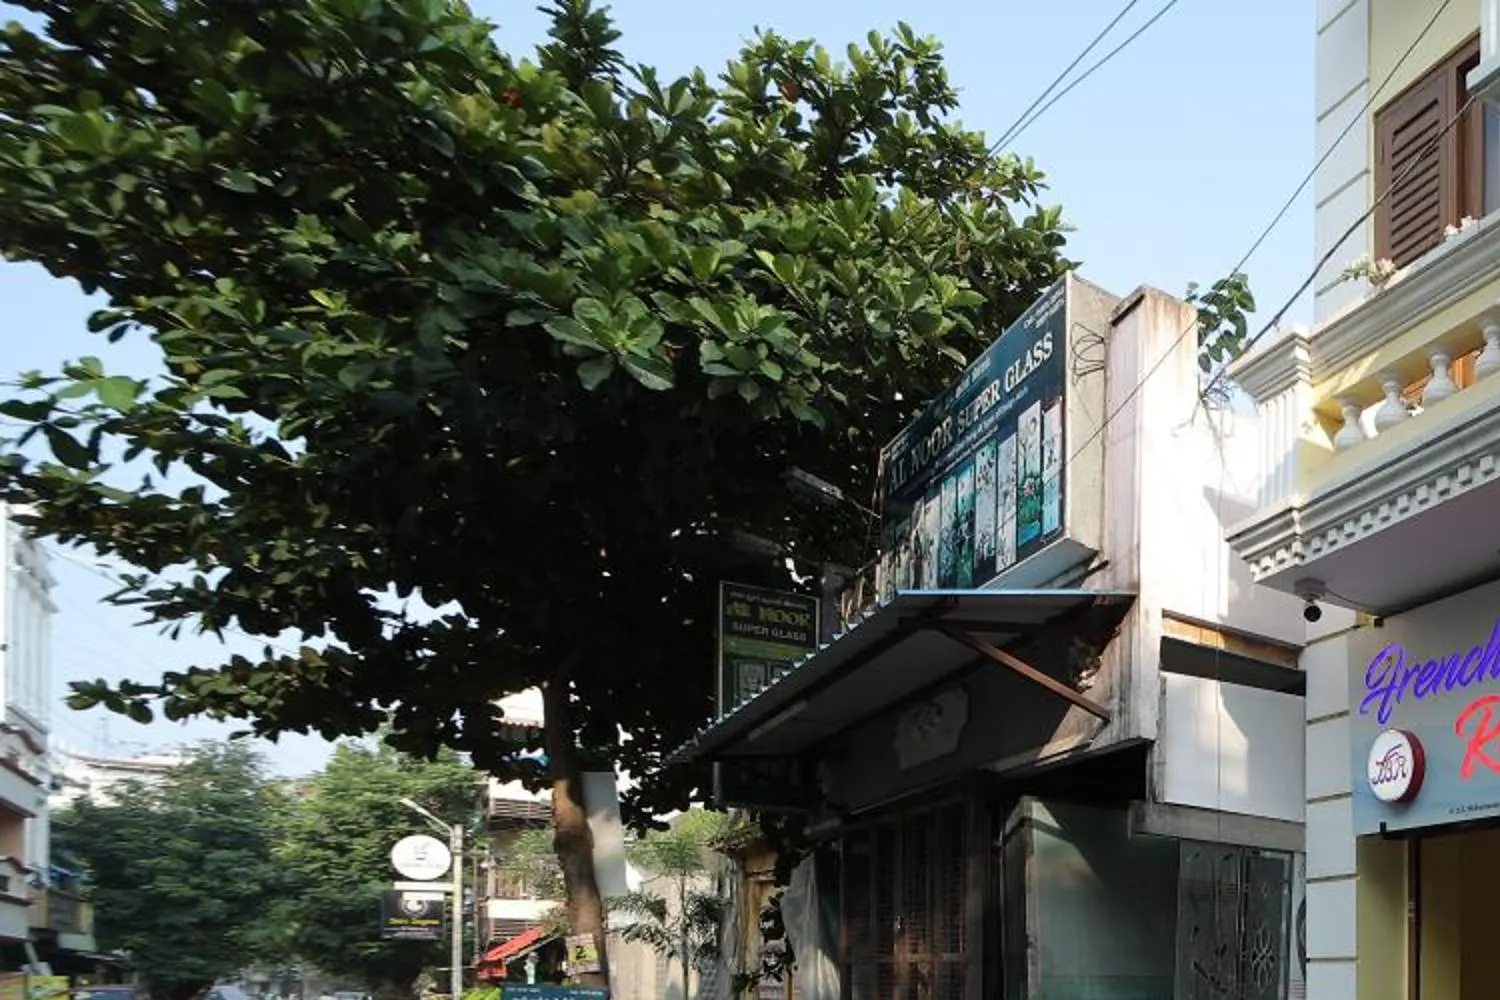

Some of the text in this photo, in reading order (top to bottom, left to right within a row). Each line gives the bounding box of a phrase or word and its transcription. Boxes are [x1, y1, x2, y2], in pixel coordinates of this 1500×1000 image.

[911, 415, 952, 472] NOOR
[957, 379, 1000, 433] SUPER
[1004, 331, 1053, 393] GLASS
[759, 605, 811, 626] NOOR
[732, 621, 807, 641] SUPER GLASS
